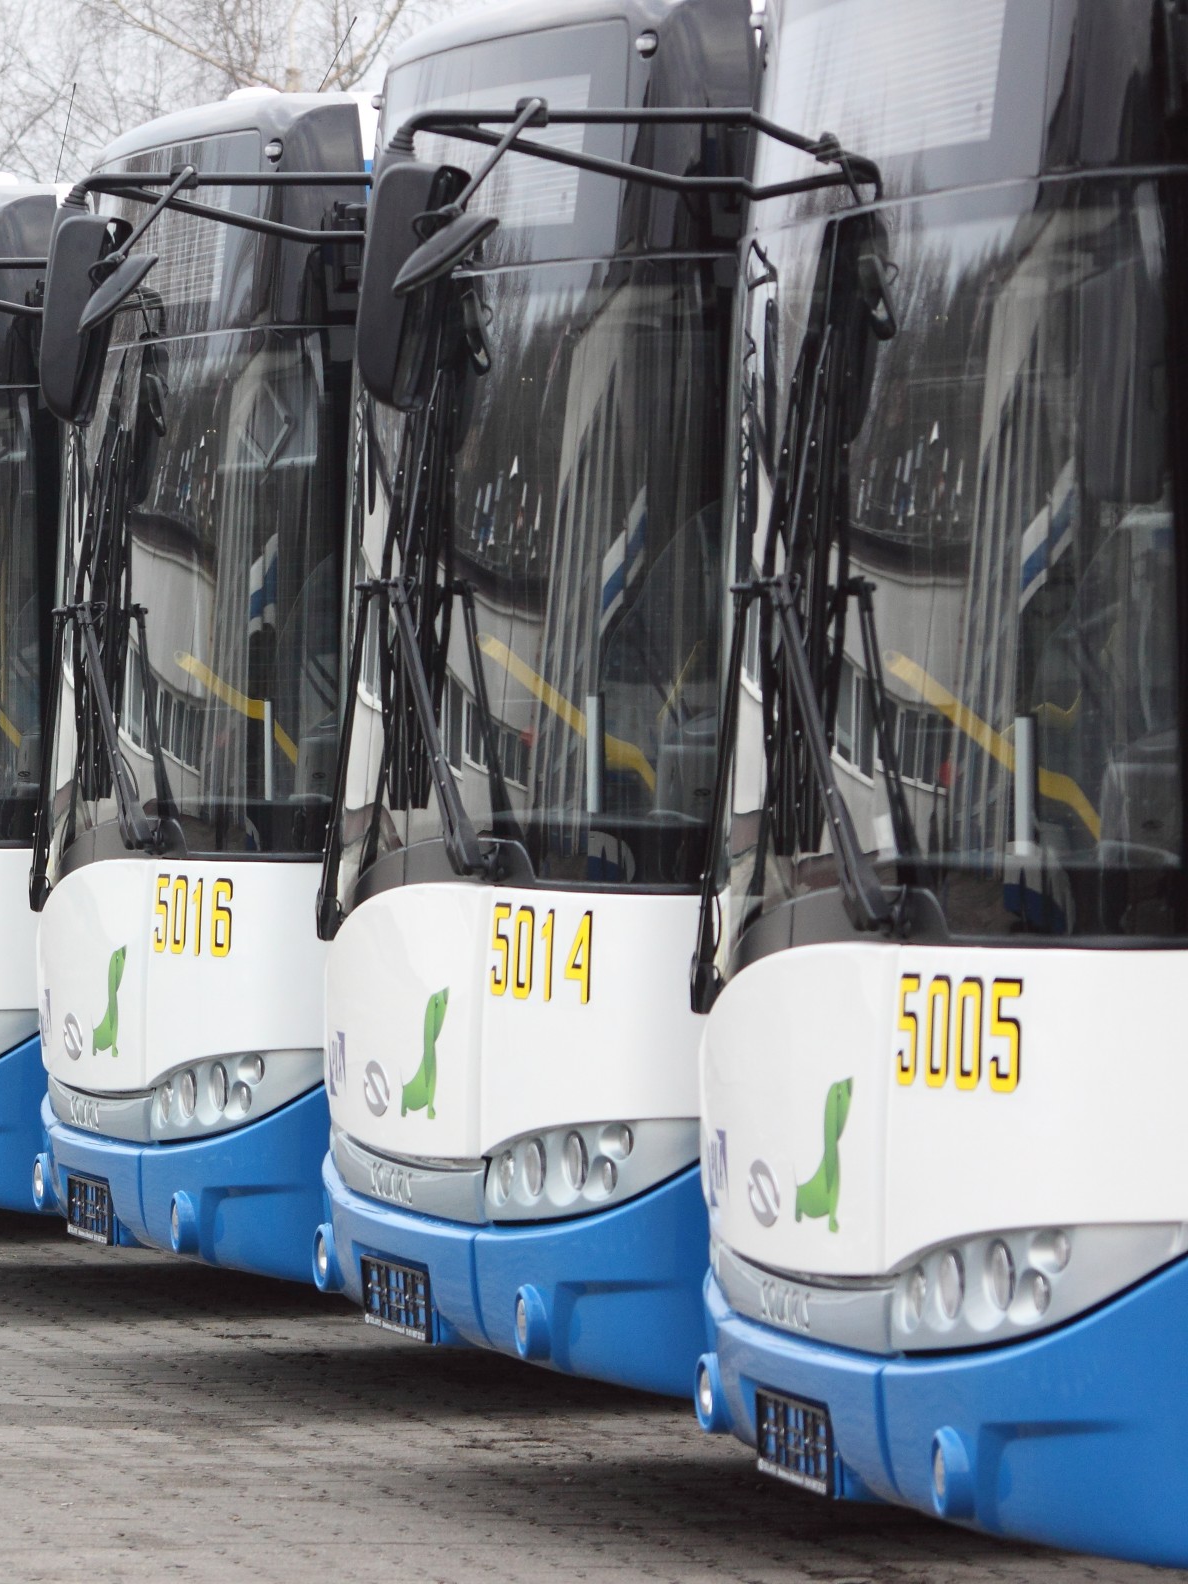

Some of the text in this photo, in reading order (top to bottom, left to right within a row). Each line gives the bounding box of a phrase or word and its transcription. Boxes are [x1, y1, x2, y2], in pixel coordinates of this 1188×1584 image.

[153, 873, 234, 958] 5016
[490, 901, 594, 1005] 5014
[896, 972, 1025, 1094] 5005
